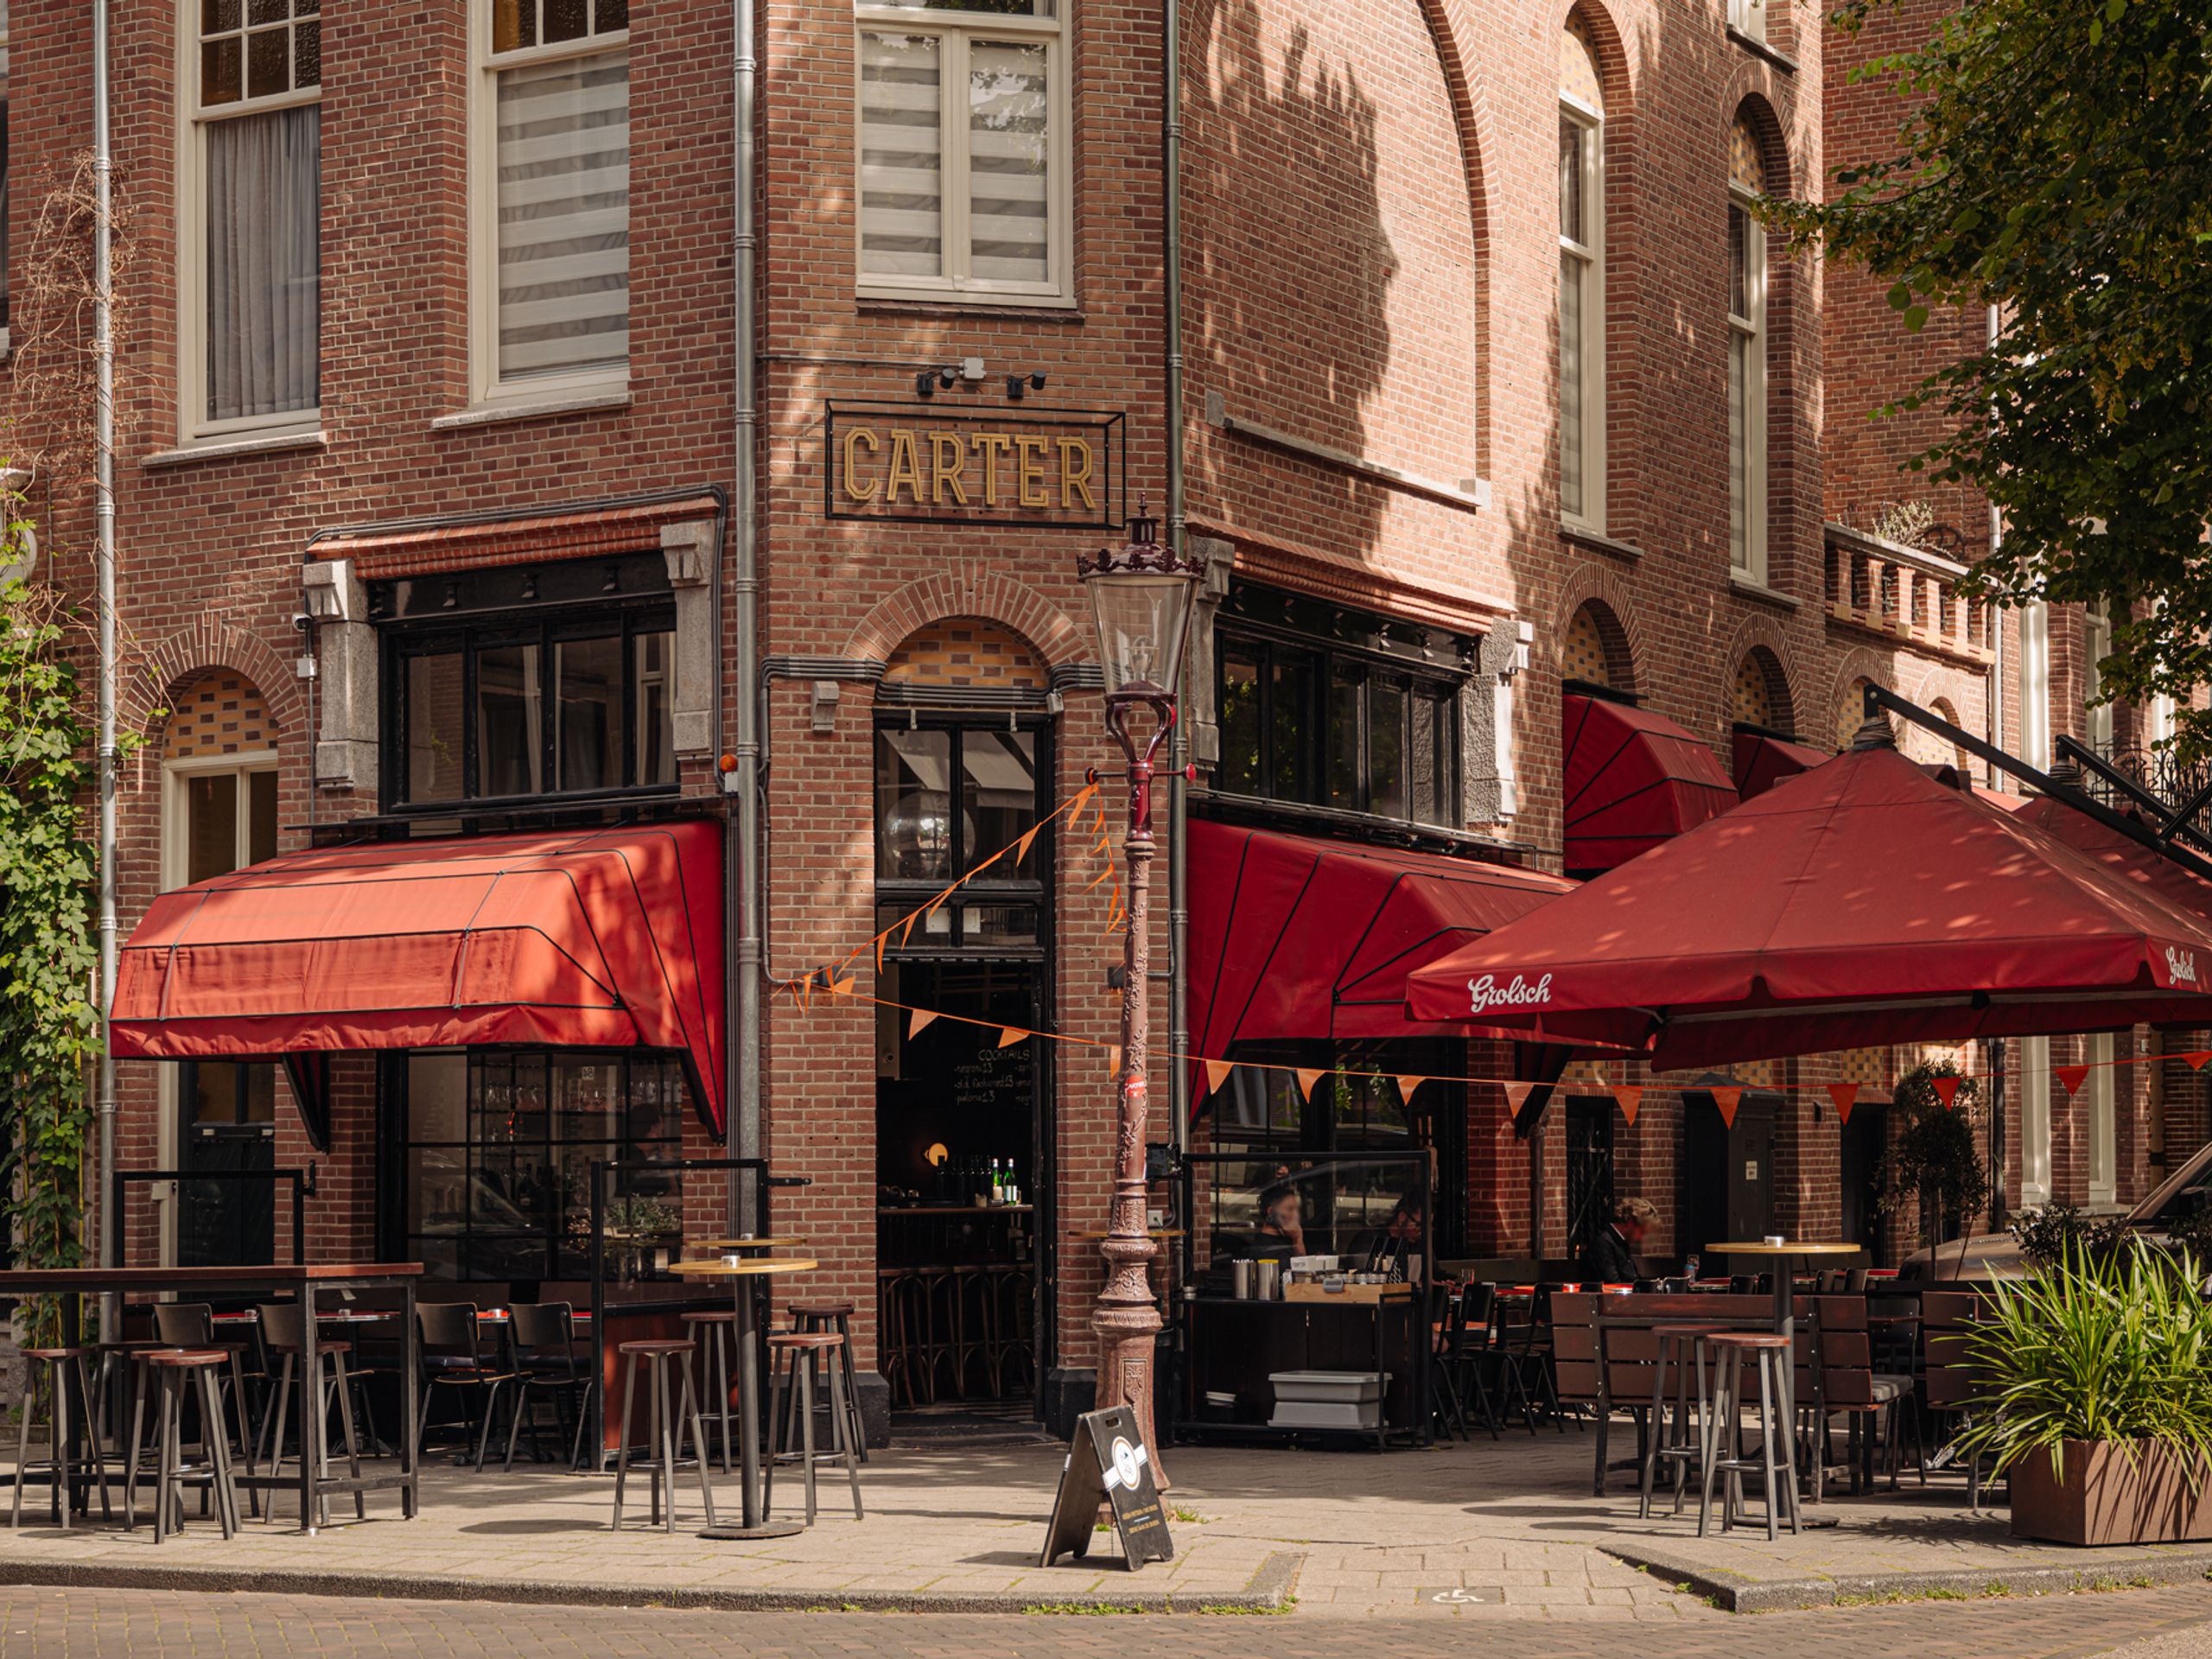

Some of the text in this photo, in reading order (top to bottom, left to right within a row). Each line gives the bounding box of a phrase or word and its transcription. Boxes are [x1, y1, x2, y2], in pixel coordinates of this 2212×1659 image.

[843, 426, 1096, 509] CARTER
[1468, 973, 1553, 1013] Grolsch
[977, 1048, 1031, 1061] COCKTAILS
